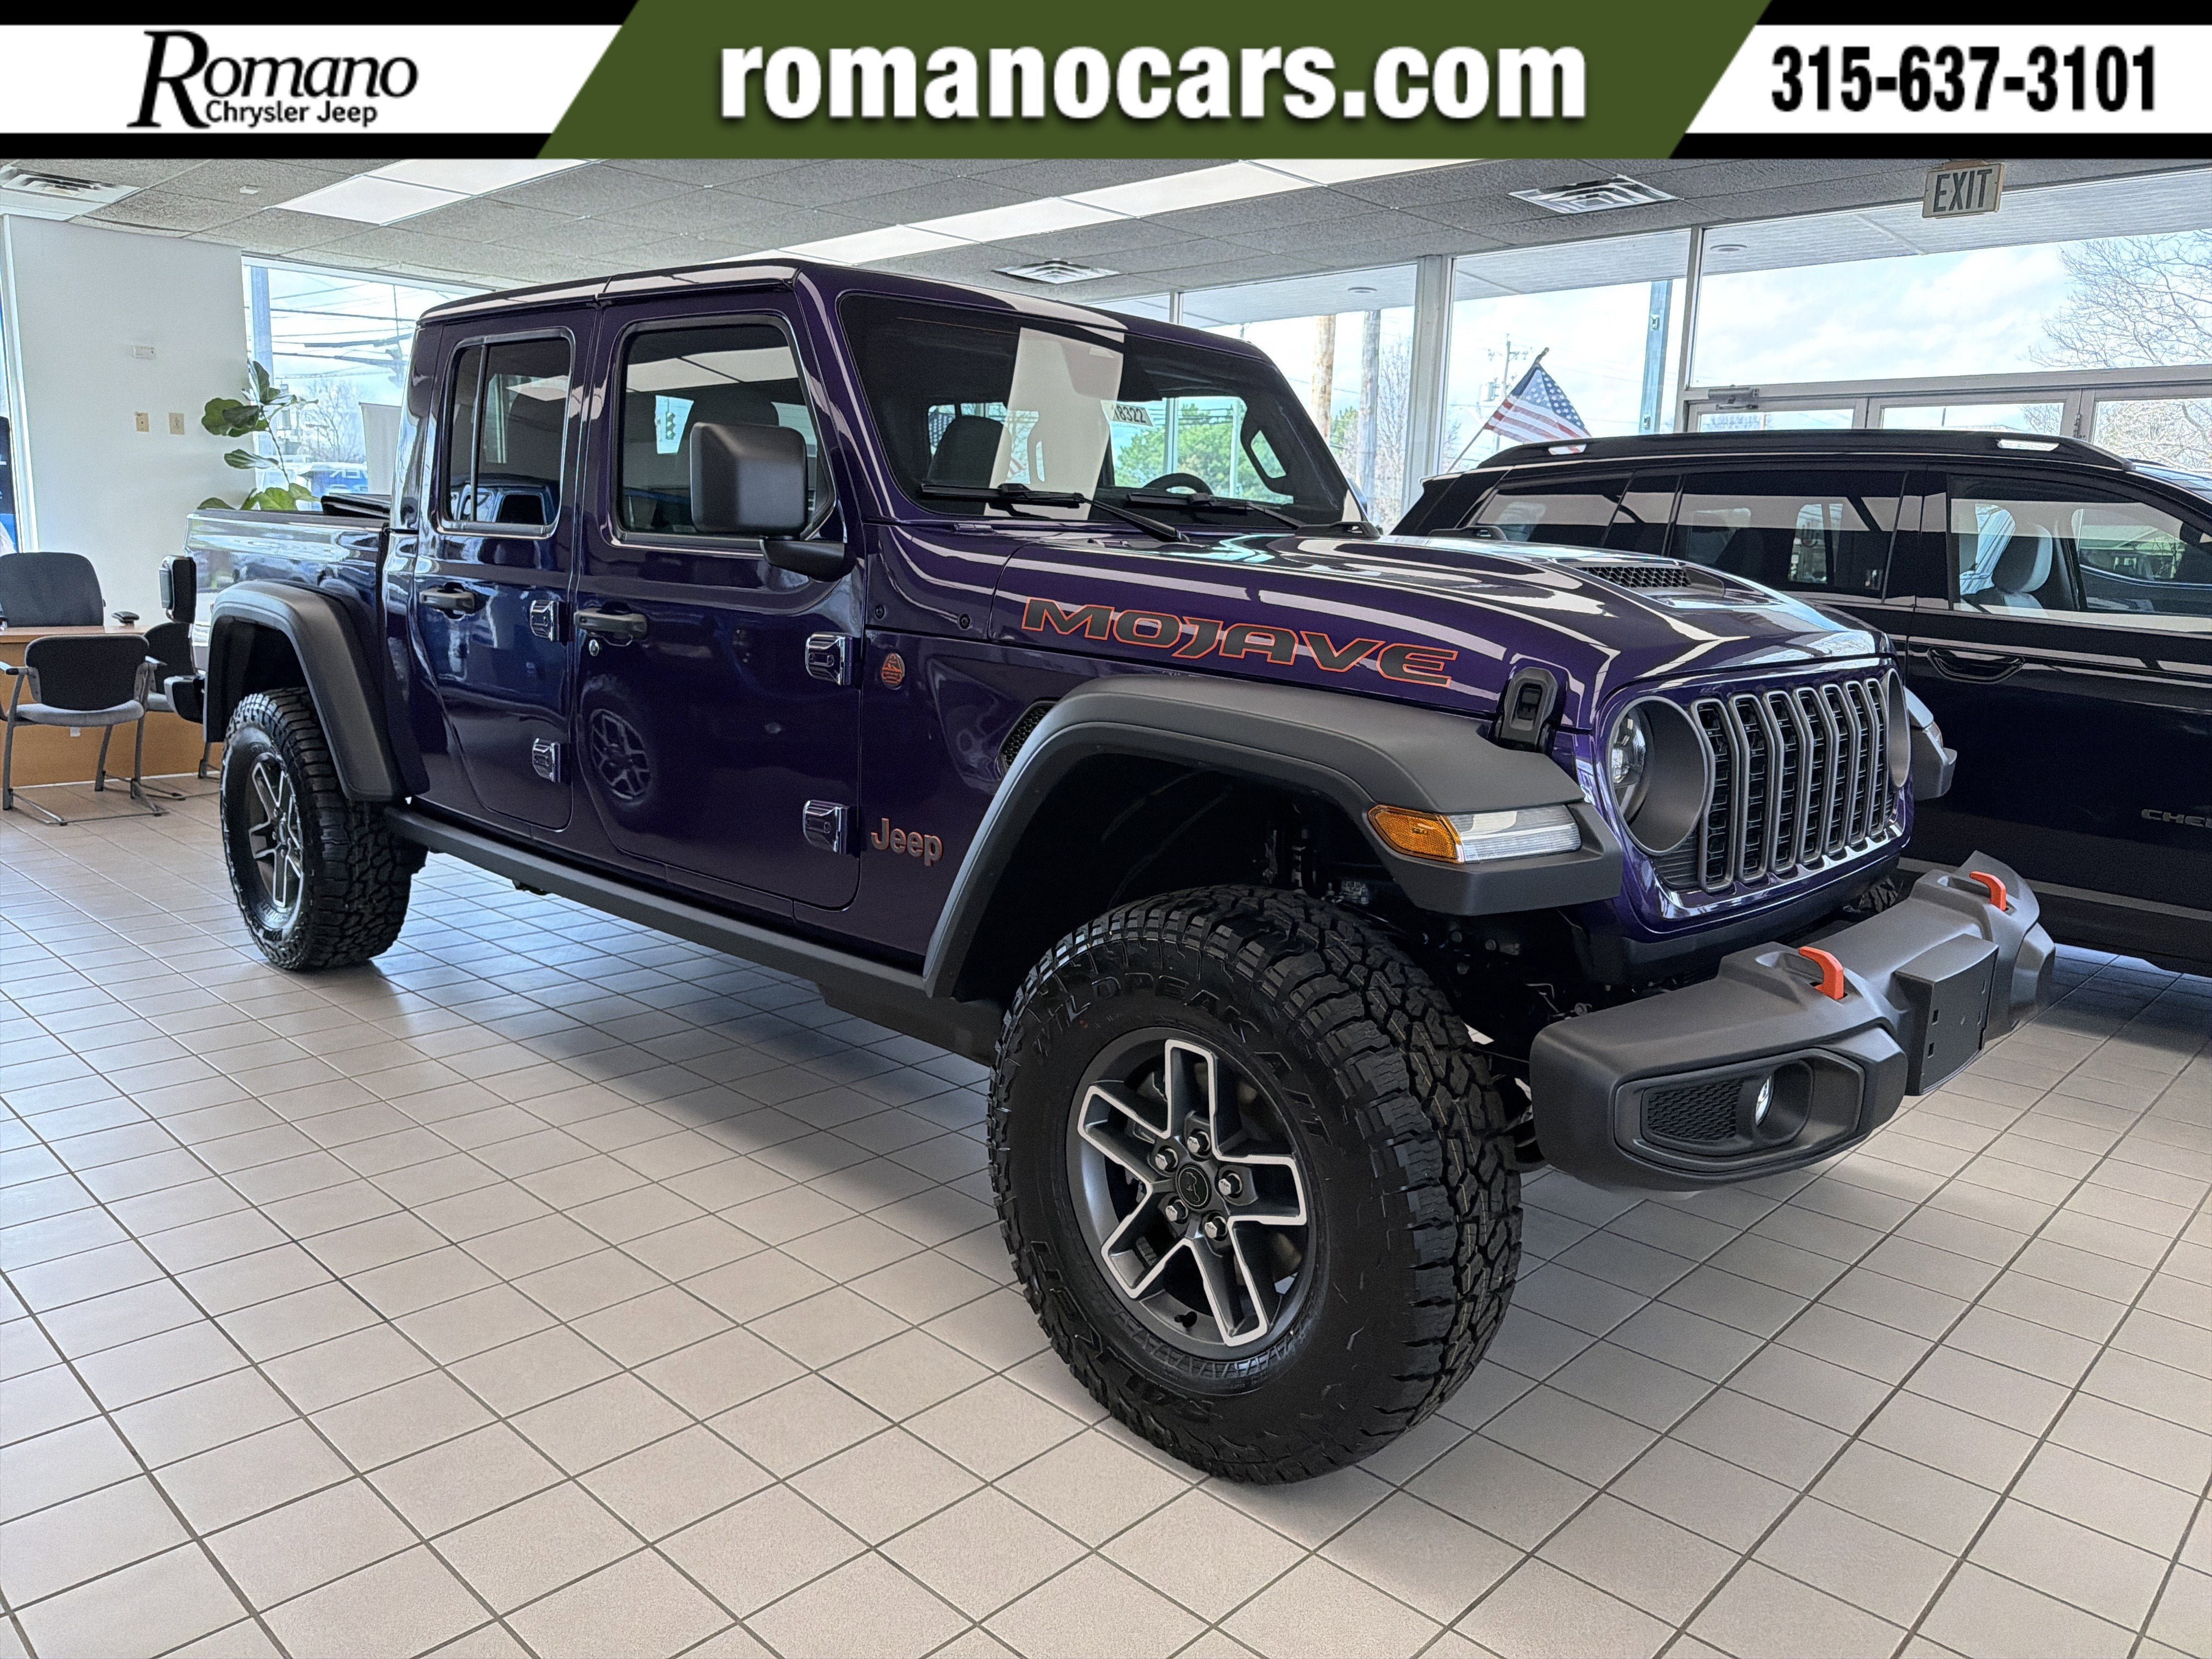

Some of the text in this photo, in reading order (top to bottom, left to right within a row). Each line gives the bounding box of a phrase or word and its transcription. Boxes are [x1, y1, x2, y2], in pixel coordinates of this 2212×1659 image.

[1933, 168, 1993, 213] EXIT
[1022, 597, 1458, 687] MOJAVE
[871, 817, 943, 866] Jeep
